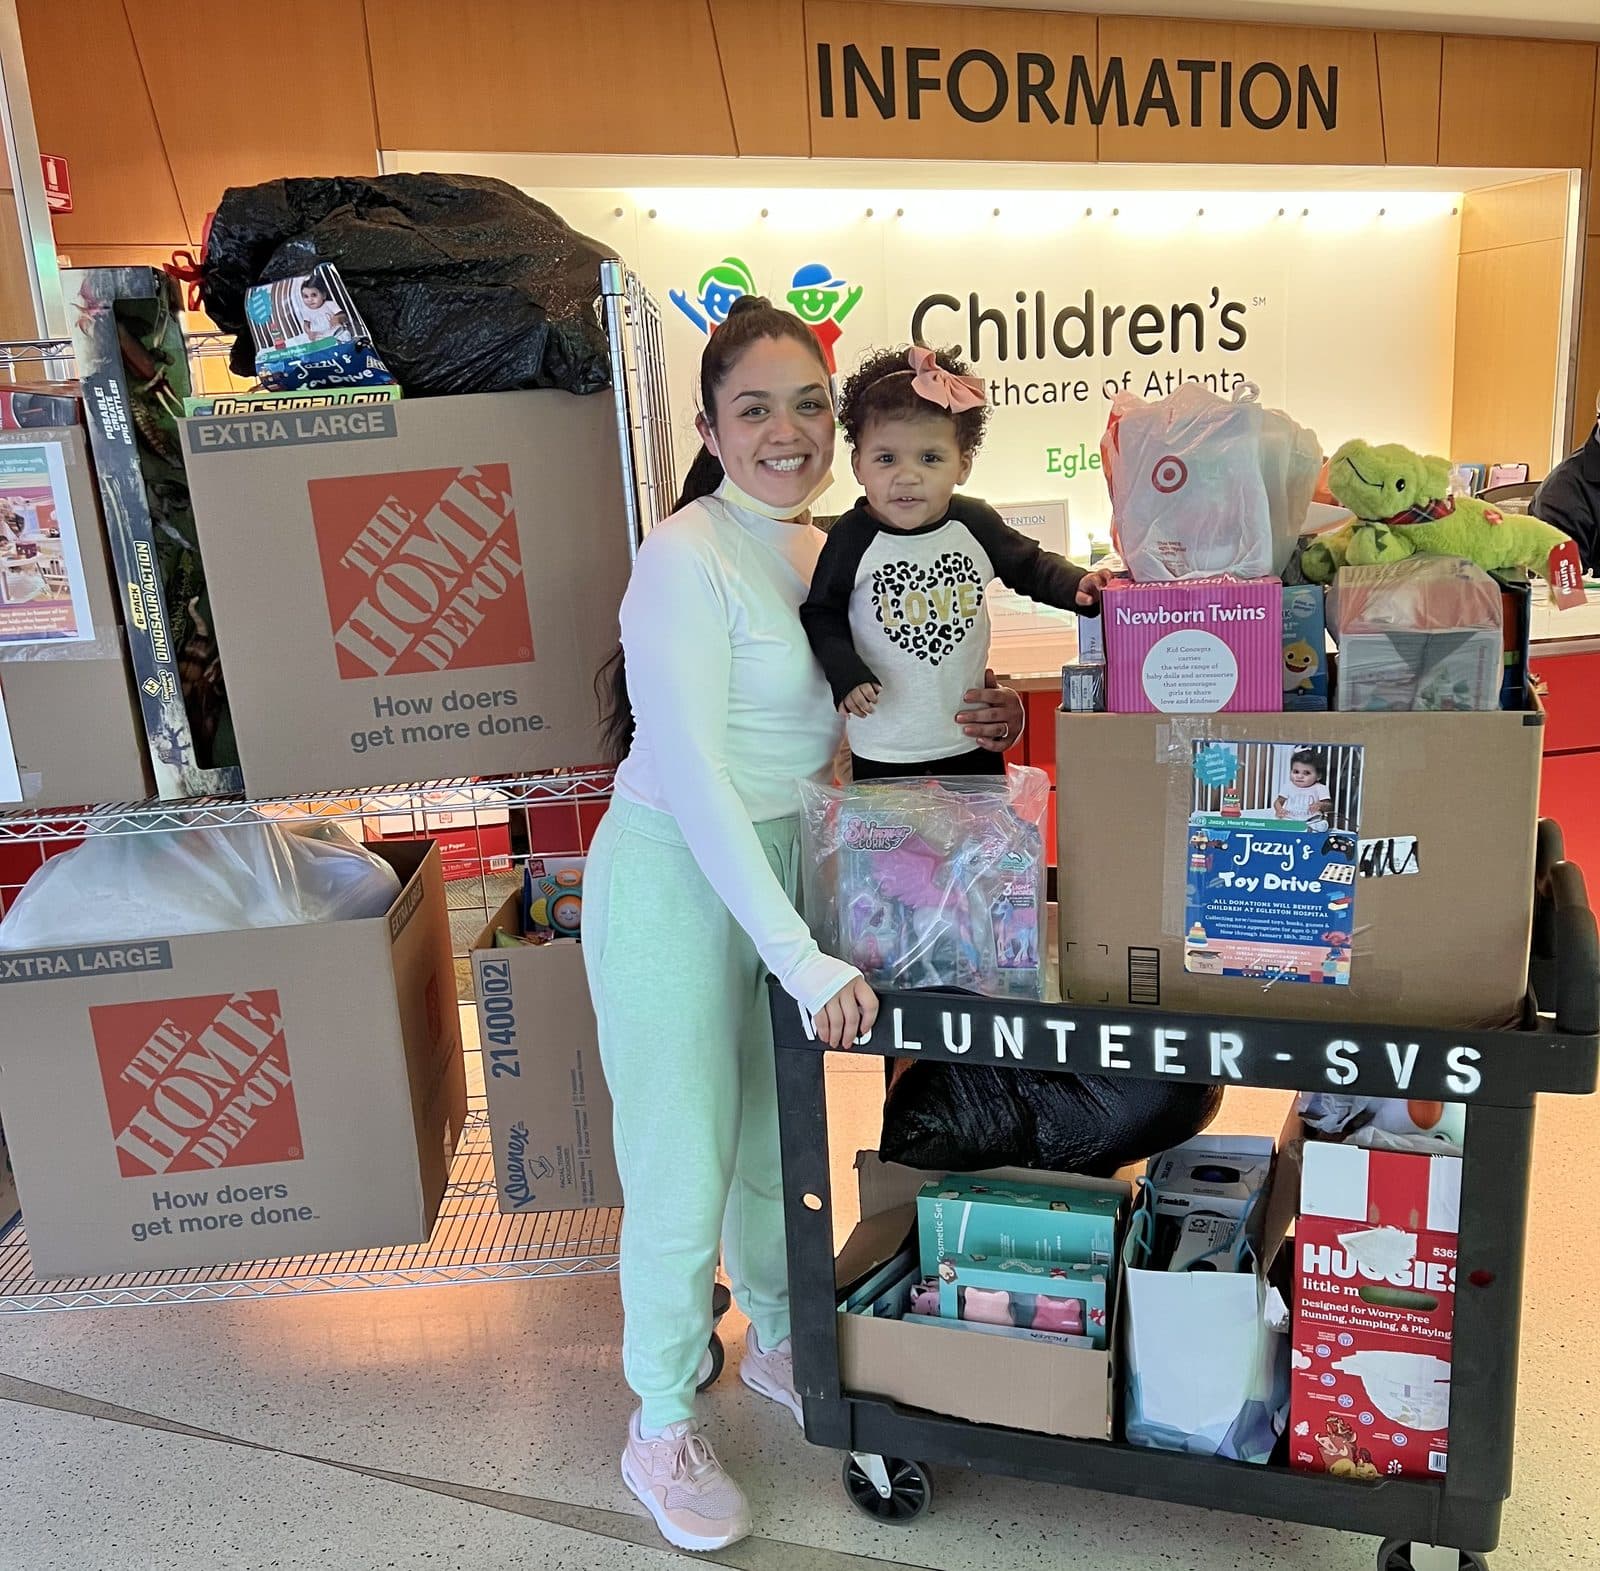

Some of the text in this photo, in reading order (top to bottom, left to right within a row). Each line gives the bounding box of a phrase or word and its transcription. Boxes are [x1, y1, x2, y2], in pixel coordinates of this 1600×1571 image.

[817, 43, 1338, 131] INFORMATION
[910, 287, 1248, 362] Children's
[288, 352, 352, 379] Jazzy's
[327, 369, 374, 383] Drive
[989, 377, 1089, 406] thcare
[1102, 371, 1132, 400] of
[93, 386, 116, 439] POSABLE!
[105, 396, 120, 431] CREATE
[108, 379, 132, 445] EPIC BATTLES!
[198, 412, 385, 446] EXTRA LARGE
[1046, 443, 1101, 478] Egle
[339, 495, 418, 579] THE
[1005, 515, 1046, 526] TENTION
[334, 465, 515, 677] HOME
[1559, 559, 1572, 595] Sunny
[136, 543, 169, 662] DINOSAUR ACTION
[414, 541, 524, 671] DEPOT
[881, 583, 977, 627] LOVE
[1115, 605, 1204, 625] Newborn
[1208, 603, 1266, 622] Twins
[373, 690, 518, 718] How doers
[349, 713, 544, 754] get more done.
[1233, 834, 1314, 871] Jazzy's
[1003, 882, 1012, 896] 3
[1218, 871, 1322, 893] Toy Drive
[1207, 904, 1242, 912] CHILDREN
[1256, 907, 1291, 915] EGLESTON
[1293, 910, 1328, 918] HOSPITAL
[1229, 899, 1271, 908] DONATIONS
[0, 946, 162, 978] XTRA LARGE
[120, 1017, 193, 1092] THE
[115, 992, 285, 1175] HOME
[191, 1054, 292, 1168] DEPOT
[504, 1127, 536, 1209] Kleenex
[152, 1183, 289, 1212] How doers
[934, 1202, 943, 1219] Set
[131, 1204, 313, 1242] get more done.
[1303, 1277, 1340, 1294] little
[1301, 1299, 1430, 1324] Designed for Worry-Free
[1301, 1309, 1452, 1340] Running, Jumping, & Playing
